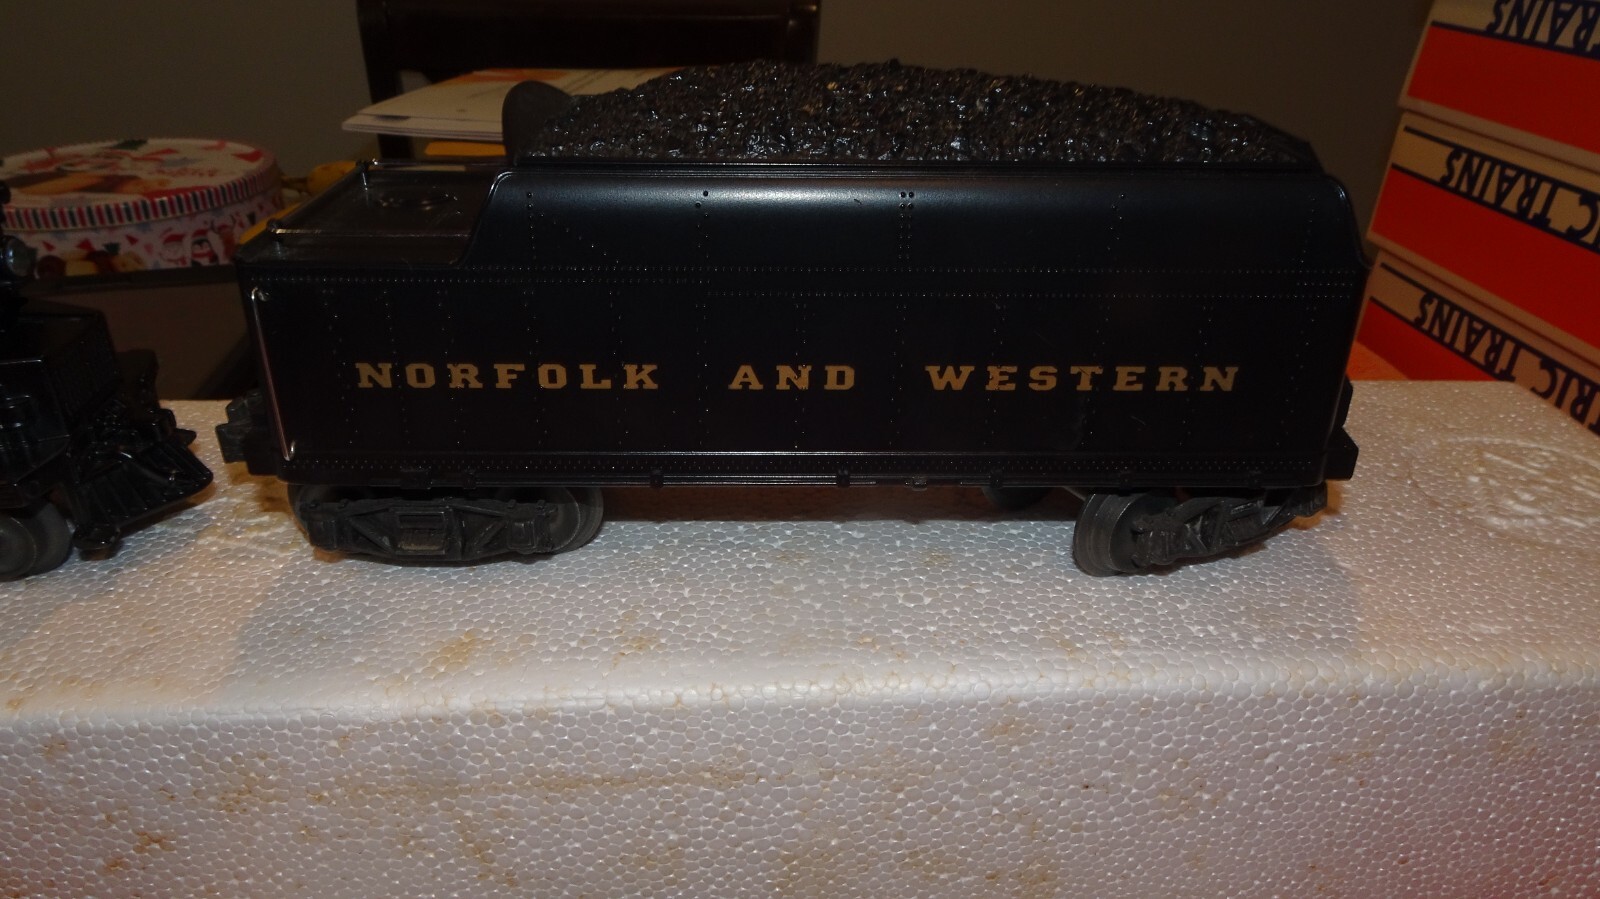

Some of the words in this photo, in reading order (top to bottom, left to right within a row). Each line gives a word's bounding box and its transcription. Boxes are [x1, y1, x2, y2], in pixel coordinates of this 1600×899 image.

[1440, 148, 1559, 228] TRAINS
[1414, 292, 1522, 382] TRAINS
[356, 363, 658, 389] NORFOLK
[728, 364, 855, 390] AND
[924, 365, 1239, 392] WESTERN
